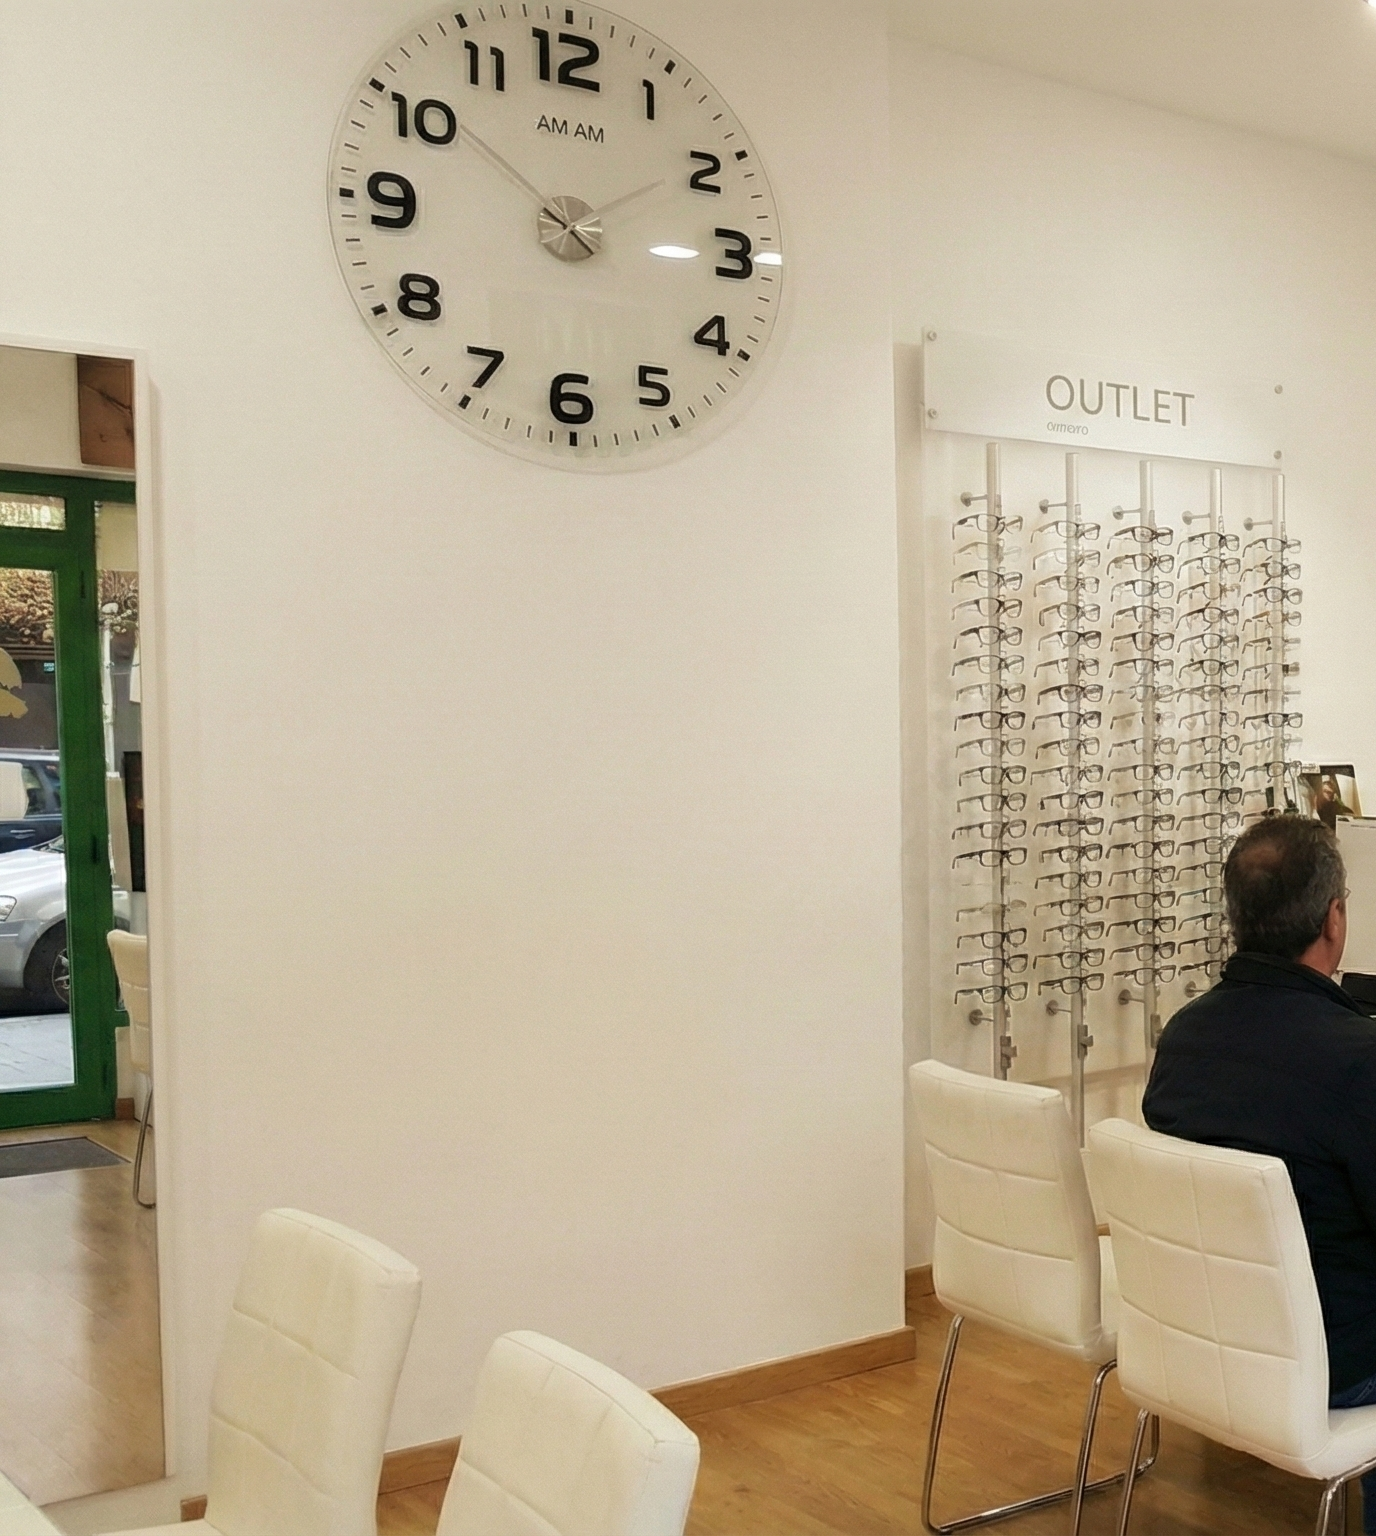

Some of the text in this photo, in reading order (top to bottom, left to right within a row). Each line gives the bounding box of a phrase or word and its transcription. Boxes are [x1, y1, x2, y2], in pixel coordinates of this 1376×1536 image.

[463, 40, 505, 91] 11
[532, 26, 600, 93] 12
[391, 91, 457, 145] 10
[642, 79, 655, 121] 1
[537, 114, 604, 143] AM AM
[690, 150, 721, 194] 2
[367, 171, 417, 229] 9
[714, 228, 753, 280] 3
[397, 273, 441, 321] 8
[693, 315, 730, 357] 4
[466, 345, 505, 389] 7
[638, 364, 671, 407] 5
[549, 373, 594, 425] 6
[1046, 374, 1195, 427] OUTLET
